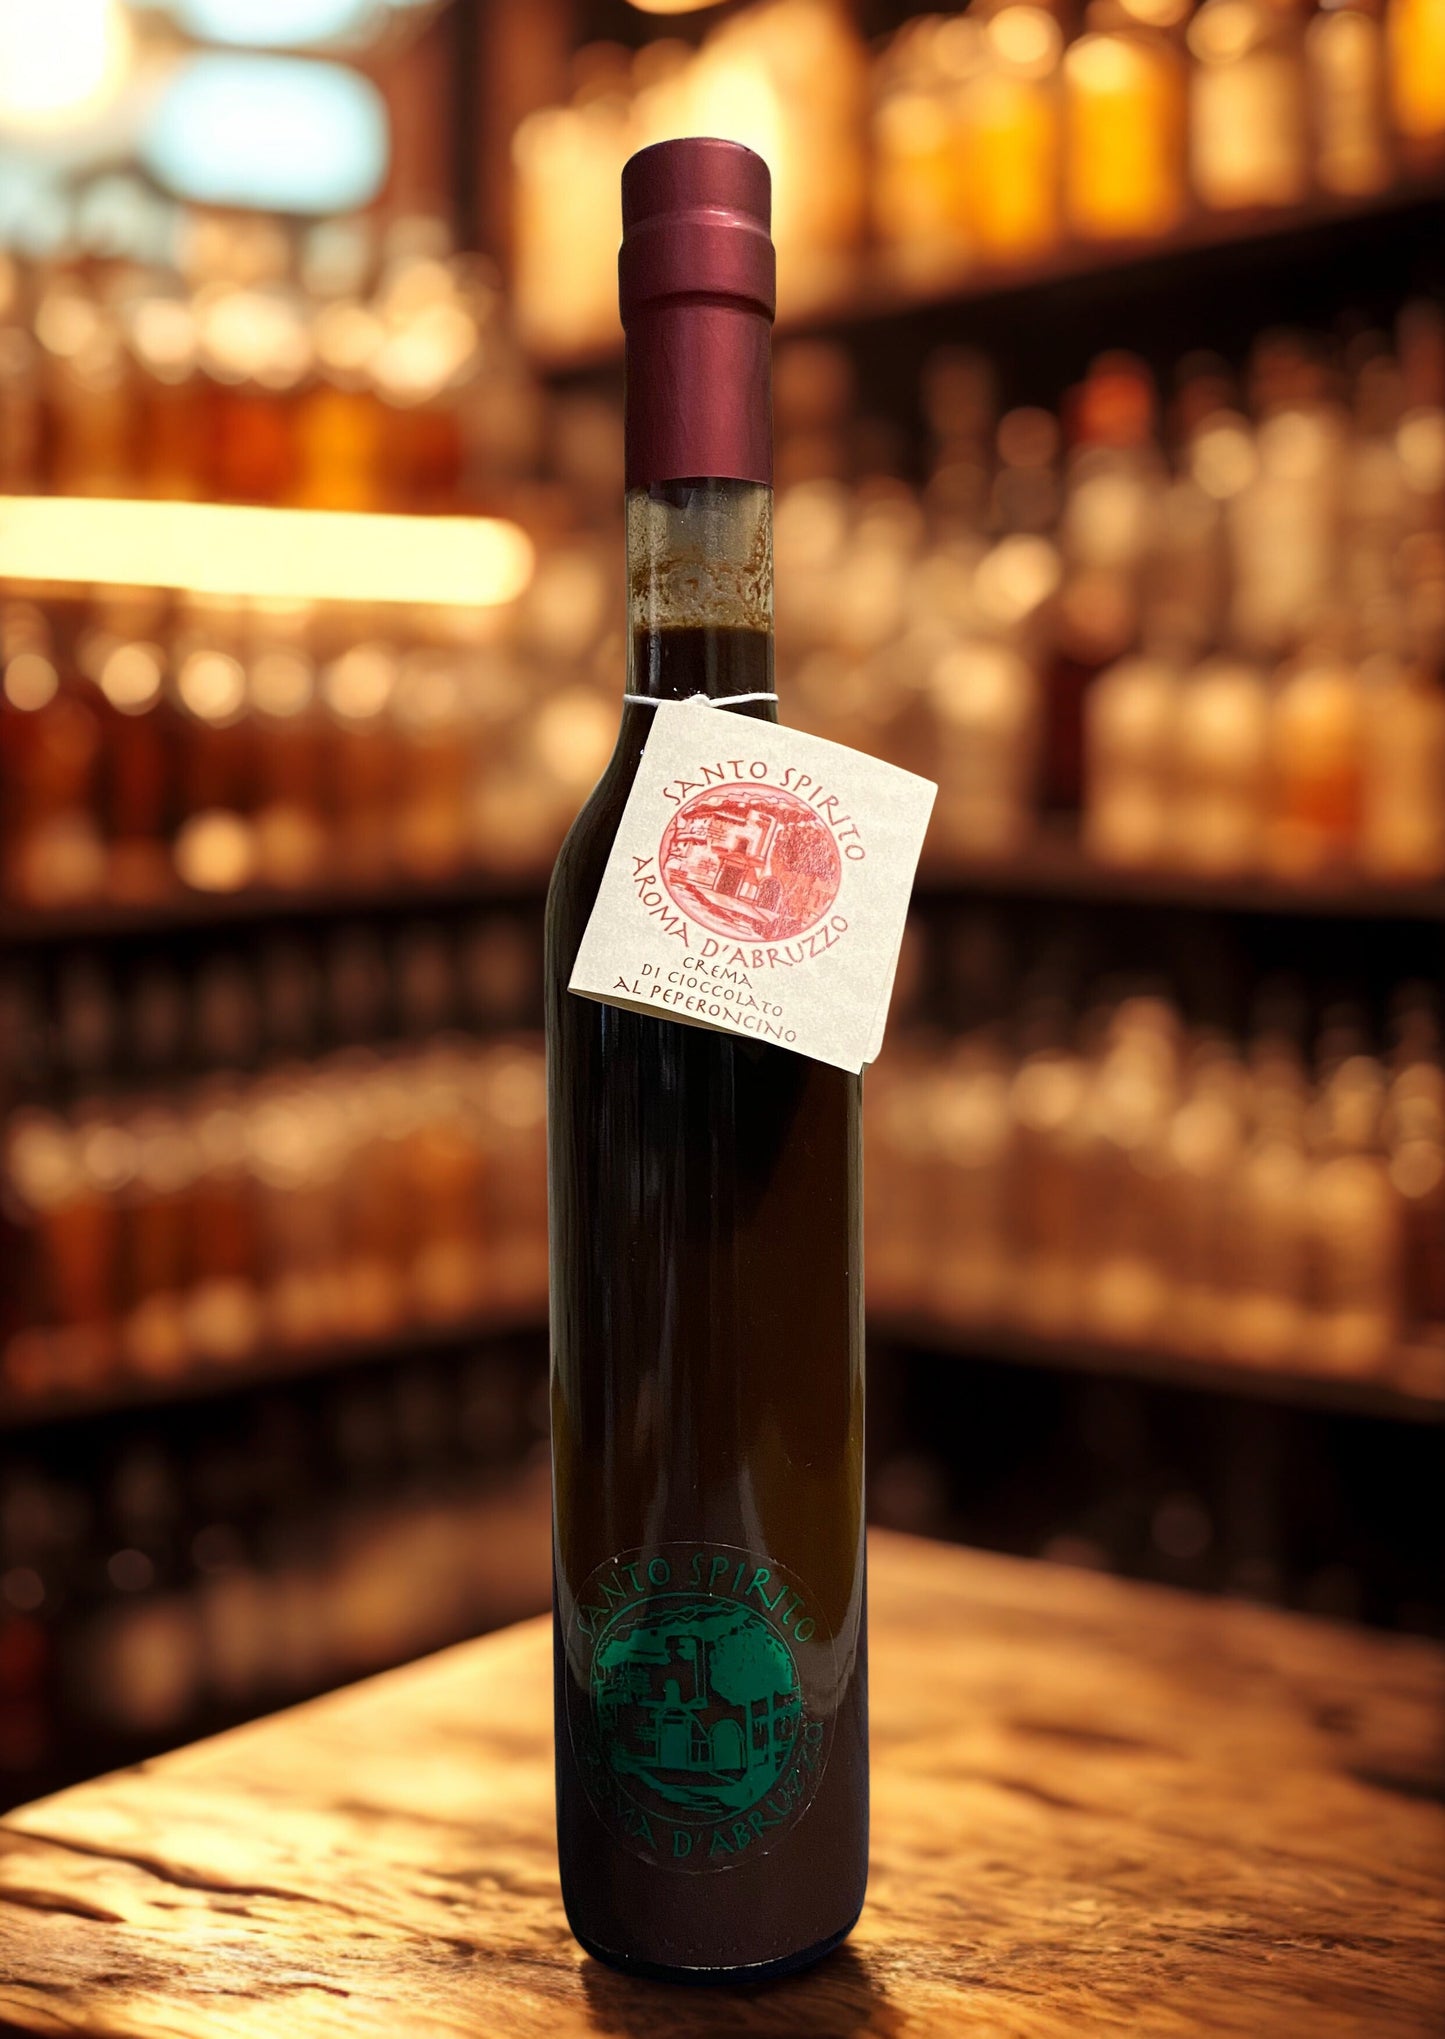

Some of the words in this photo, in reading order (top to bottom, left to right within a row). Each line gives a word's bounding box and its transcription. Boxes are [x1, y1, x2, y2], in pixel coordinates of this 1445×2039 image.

[663, 759, 768, 806] SANTO
[779, 767, 866, 862] SPIRITO
[632, 856, 690, 948] AROMA
[700, 915, 849, 969] D'ABRUZZO
[613, 976, 642, 995] AL
[650, 985, 797, 1043] PEPERONCINO
[641, 963, 660, 979] DI
[668, 971, 783, 1017] CIOCCOLATO
[683, 956, 753, 989] CREMA
[576, 1557, 671, 1645] SANTO
[689, 1552, 816, 1643] SPIRITO
[573, 1722, 658, 1851] OMA
